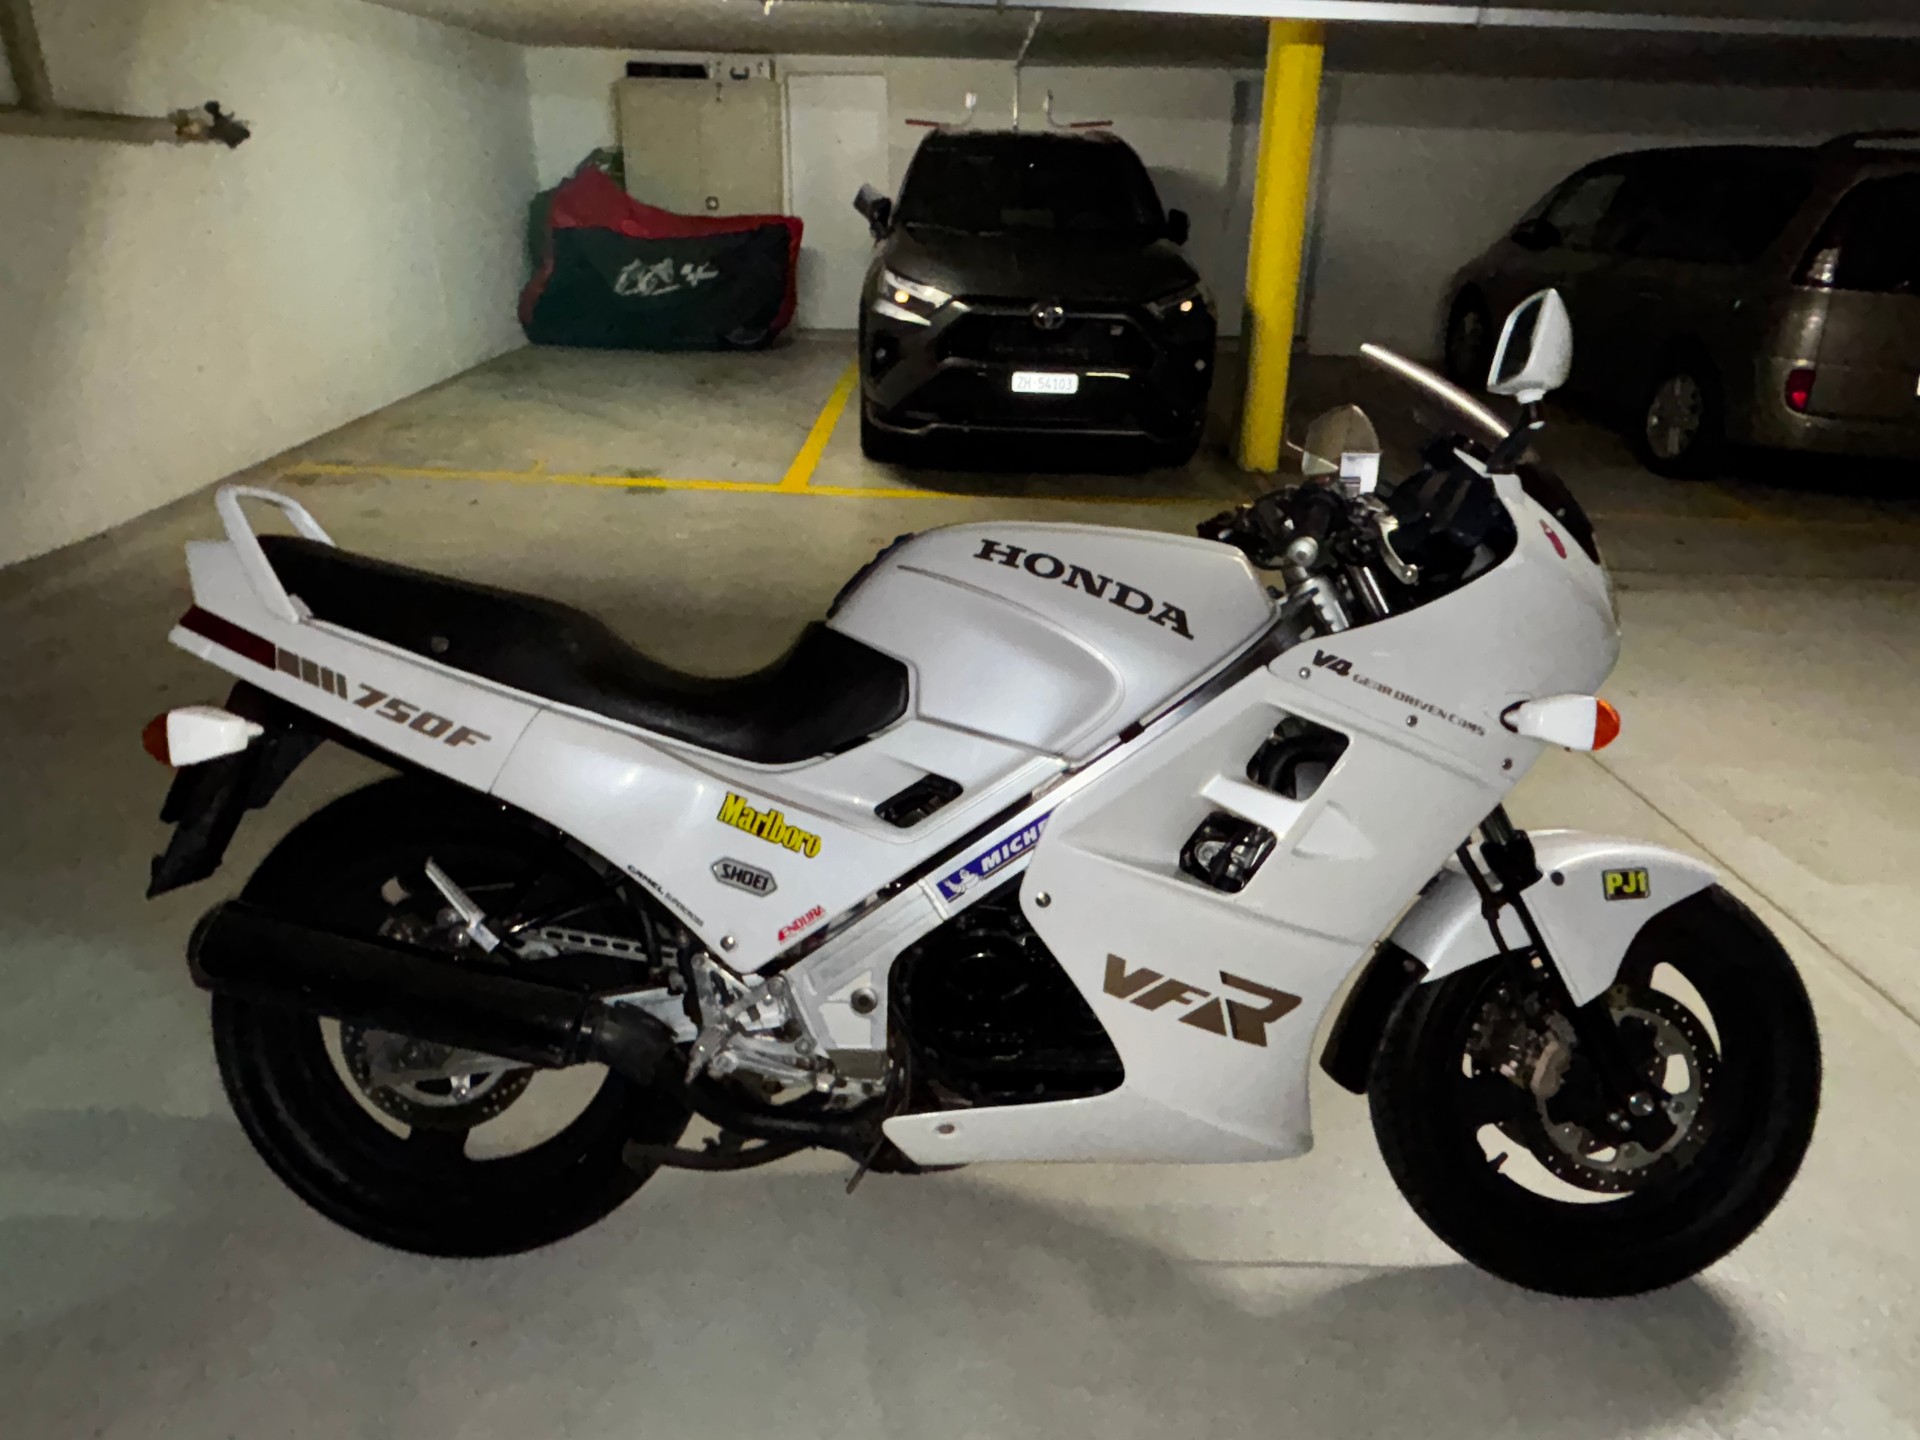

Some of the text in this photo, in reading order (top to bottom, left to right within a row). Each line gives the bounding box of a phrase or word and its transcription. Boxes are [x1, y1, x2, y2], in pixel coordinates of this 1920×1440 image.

[973, 538, 1195, 640] HONDA
[353, 682, 492, 747] 750F
[1312, 649, 1486, 737] V4 GEAR DRIVEN CAMS
[717, 791, 822, 858] Marlboro
[721, 863, 769, 891] SHOEI
[1605, 871, 1648, 895] PJ1
[1103, 953, 1302, 1048] VFR
